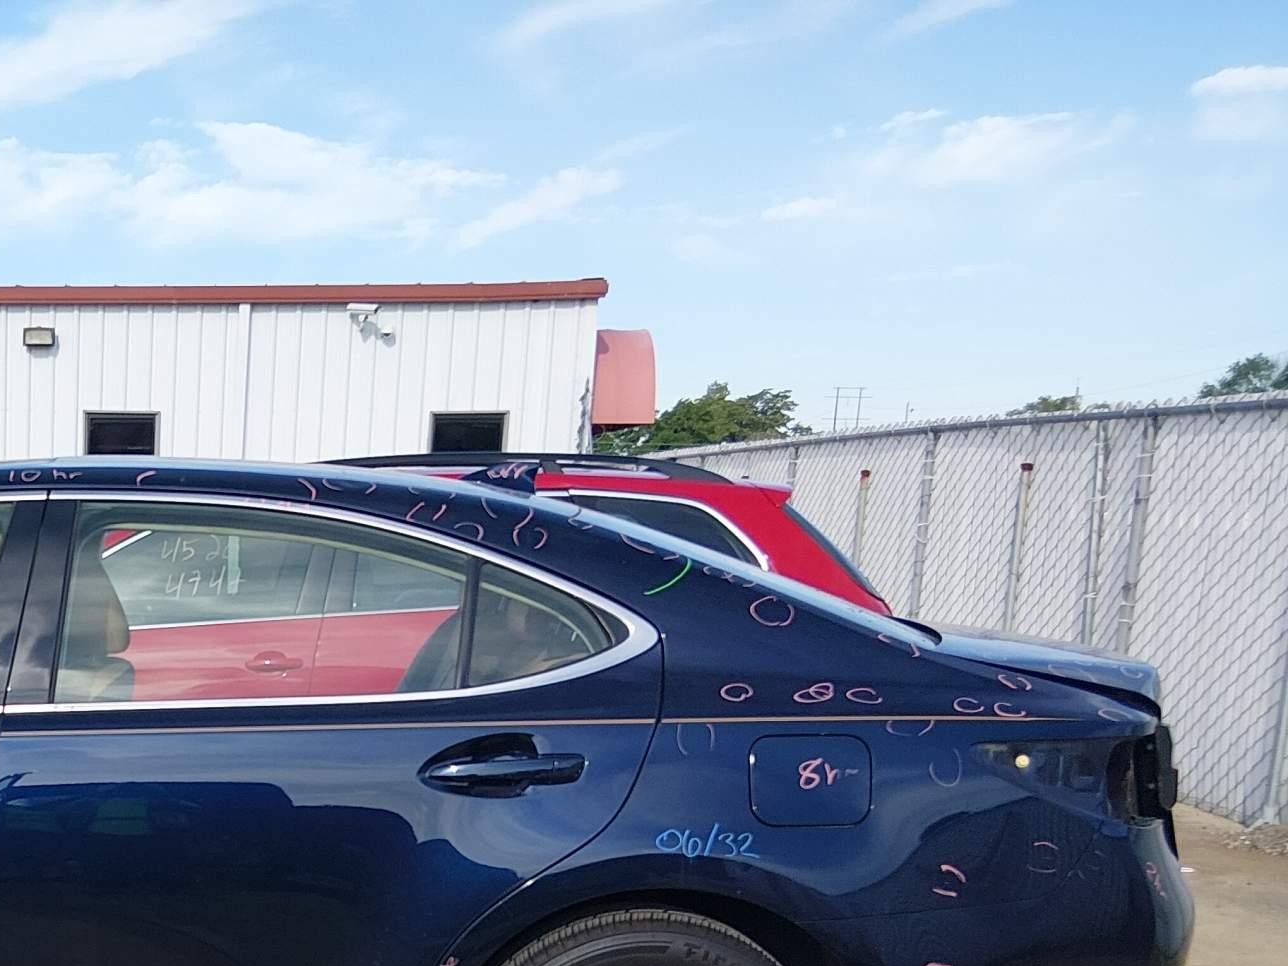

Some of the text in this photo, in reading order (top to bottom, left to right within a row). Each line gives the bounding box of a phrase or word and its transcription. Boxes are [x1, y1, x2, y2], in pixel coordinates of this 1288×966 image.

[9, 468, 83, 482] 10 hr
[655, 823, 761, 857] 06/32
